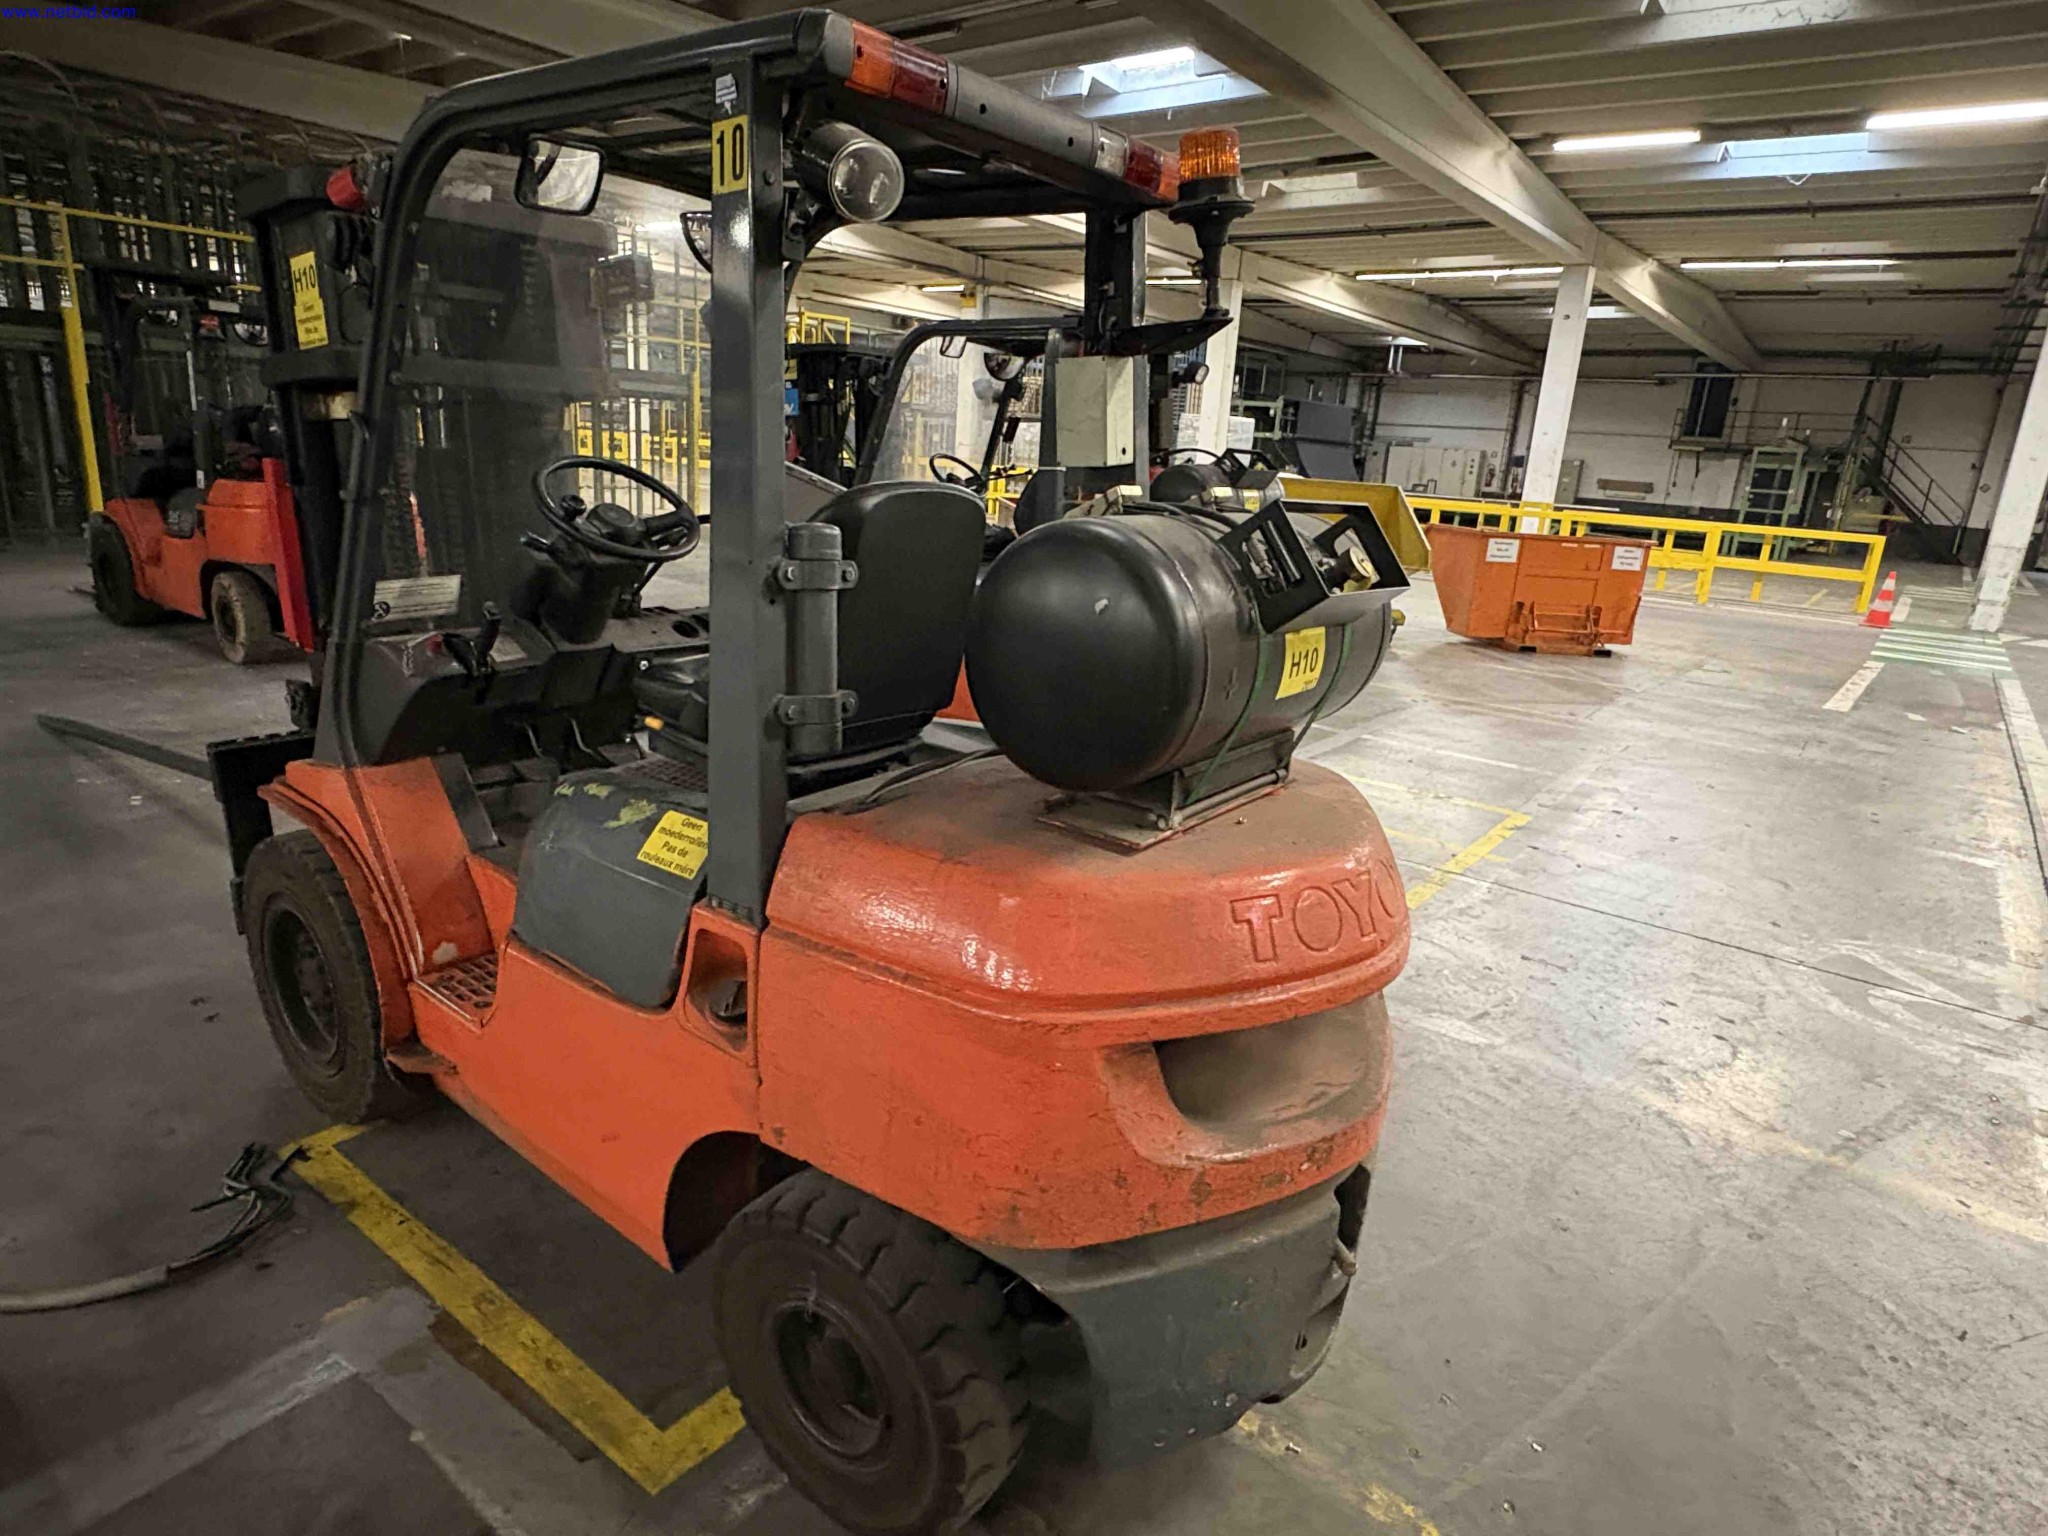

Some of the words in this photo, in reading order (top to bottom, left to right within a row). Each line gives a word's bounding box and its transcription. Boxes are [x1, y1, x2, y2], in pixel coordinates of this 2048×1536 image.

[717, 123, 744, 186] 10
[293, 264, 316, 293] H10
[1289, 647, 1319, 680] H10
[681, 817, 703, 831] Geen
[640, 851, 673, 868] rouleaux
[662, 841, 677, 854] Pas
[677, 846, 689, 858] de
